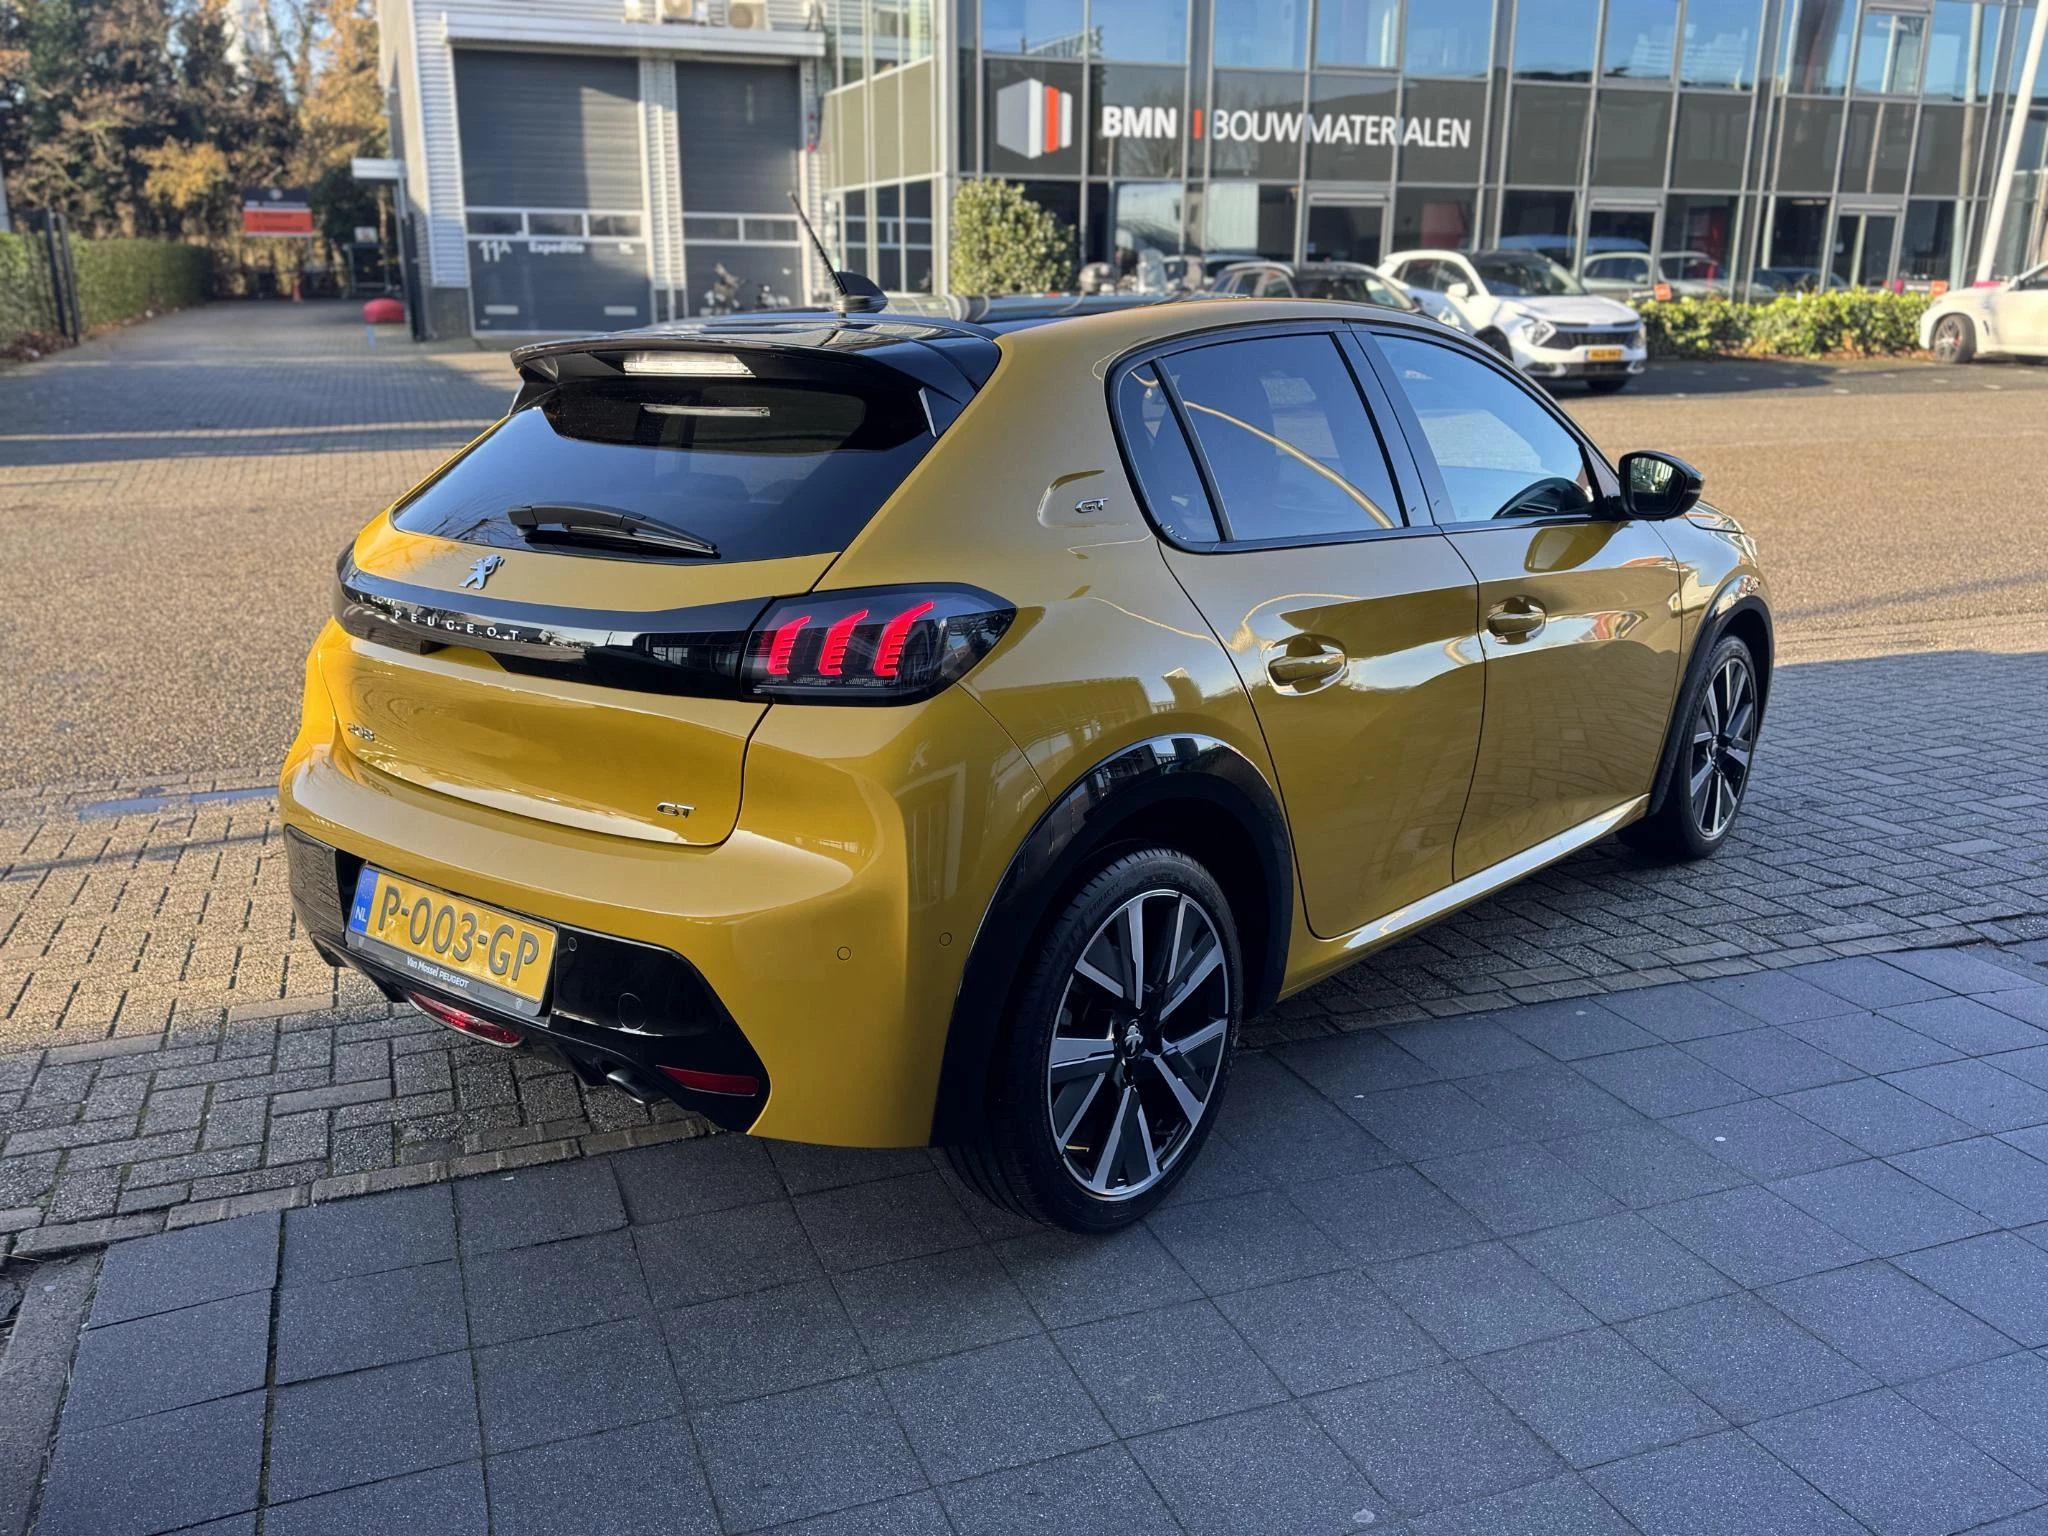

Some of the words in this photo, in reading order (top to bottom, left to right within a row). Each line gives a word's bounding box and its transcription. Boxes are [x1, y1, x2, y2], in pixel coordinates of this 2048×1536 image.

[1102, 106, 1177, 139] BMN
[1212, 109, 1471, 148] BOUWMATERIALEN
[1075, 497, 1108, 514] GT
[394, 609, 519, 641] PEUGEOT
[347, 721, 376, 742] 208
[656, 802, 696, 819] GT
[354, 905, 367, 923] NL
[378, 884, 540, 981] P-003-GP
[406, 956, 417, 969] Van
[439, 971, 469, 989] PEUGEOT
